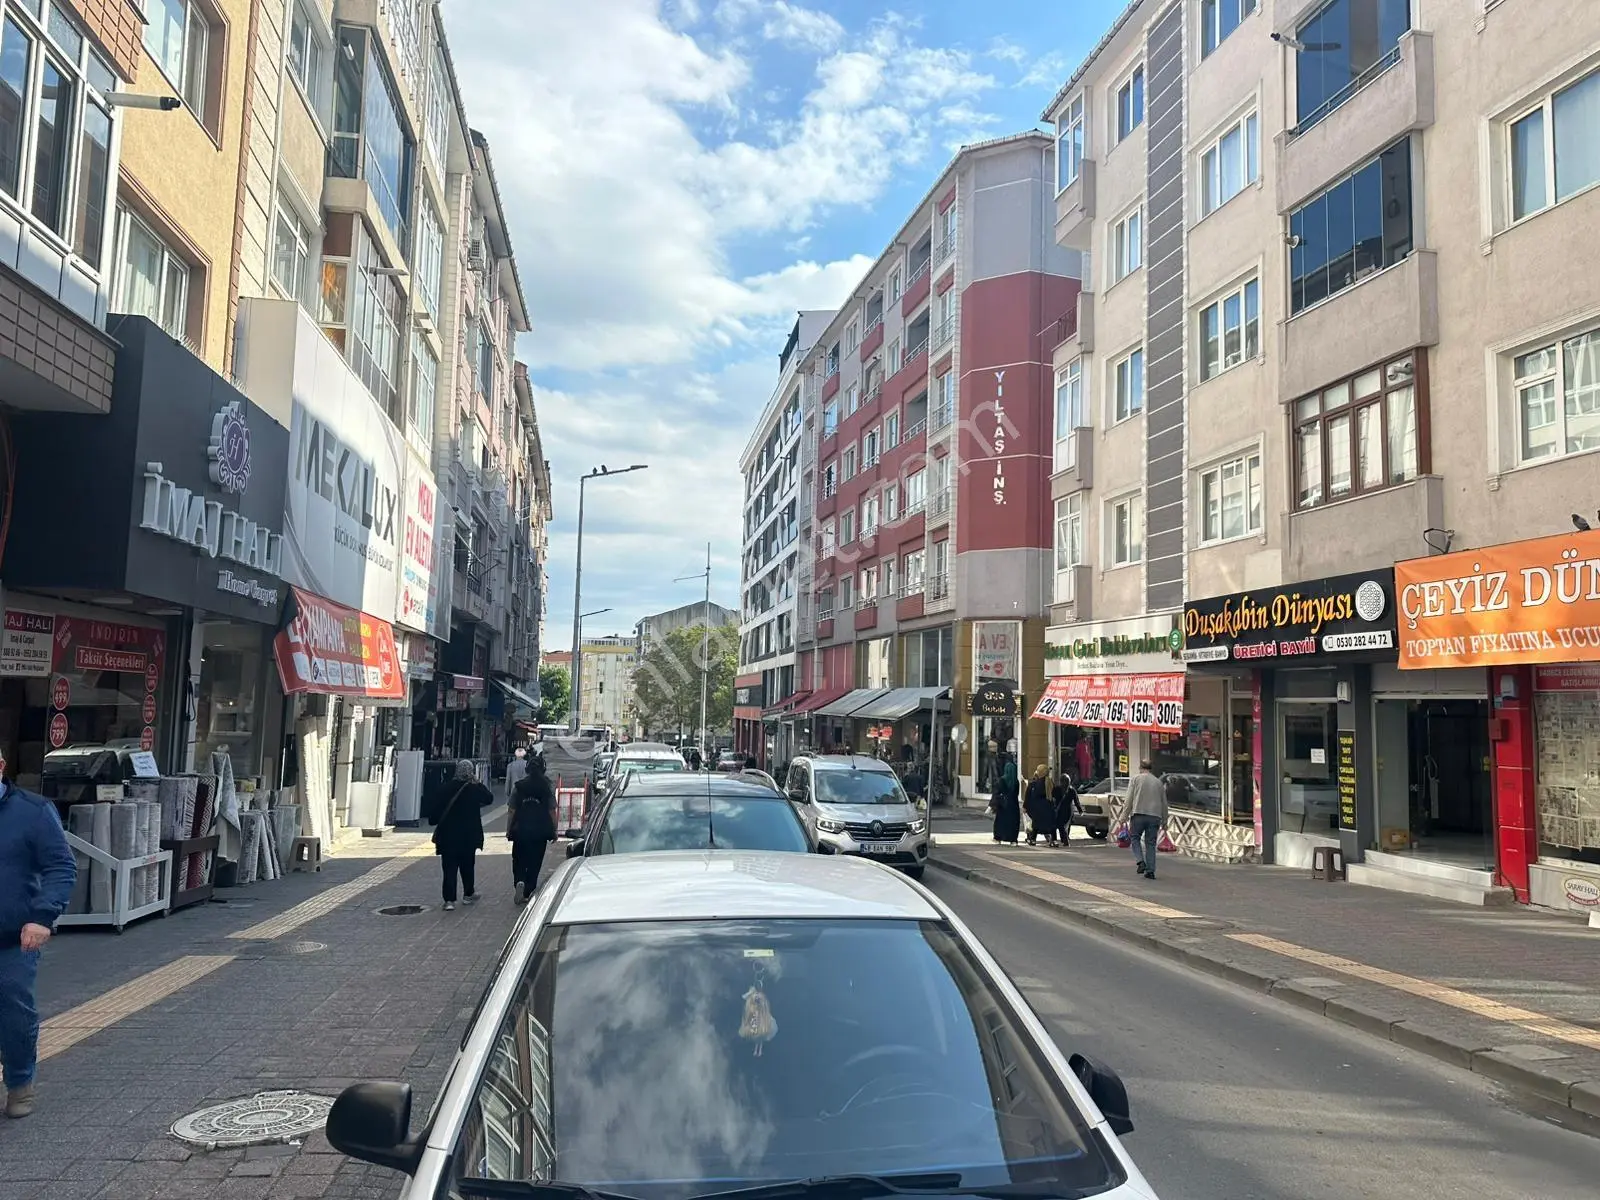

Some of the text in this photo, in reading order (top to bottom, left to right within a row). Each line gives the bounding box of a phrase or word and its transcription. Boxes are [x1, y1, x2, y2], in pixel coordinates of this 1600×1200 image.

[994, 370, 1006, 454] YILTAŞ
[295, 409, 397, 546] MEKALUX
[993, 460, 1007, 505] İNŞ.
[139, 462, 284, 576] İMAJ HALI
[1401, 562, 1509, 630] ÇEYİZ
[27, 617, 51, 631] HALI
[1185, 592, 1354, 643] Duşakabin Dünyası
[1232, 636, 1316, 659] ÜRETİCİ BAYİİ
[1336, 633, 1388, 648] 0530 282 44 72
[1406, 635, 1465, 658] TOPTAN
[1470, 628, 1556, 655] FİYATINA
[104, 652, 145, 670] Seçenekleri
[1062, 700, 1077, 719] 150
[1083, 701, 1100, 721] 250
[1107, 702, 1123, 722] 169
[1131, 702, 1148, 723] 150
[1157, 703, 1176, 725] 300
